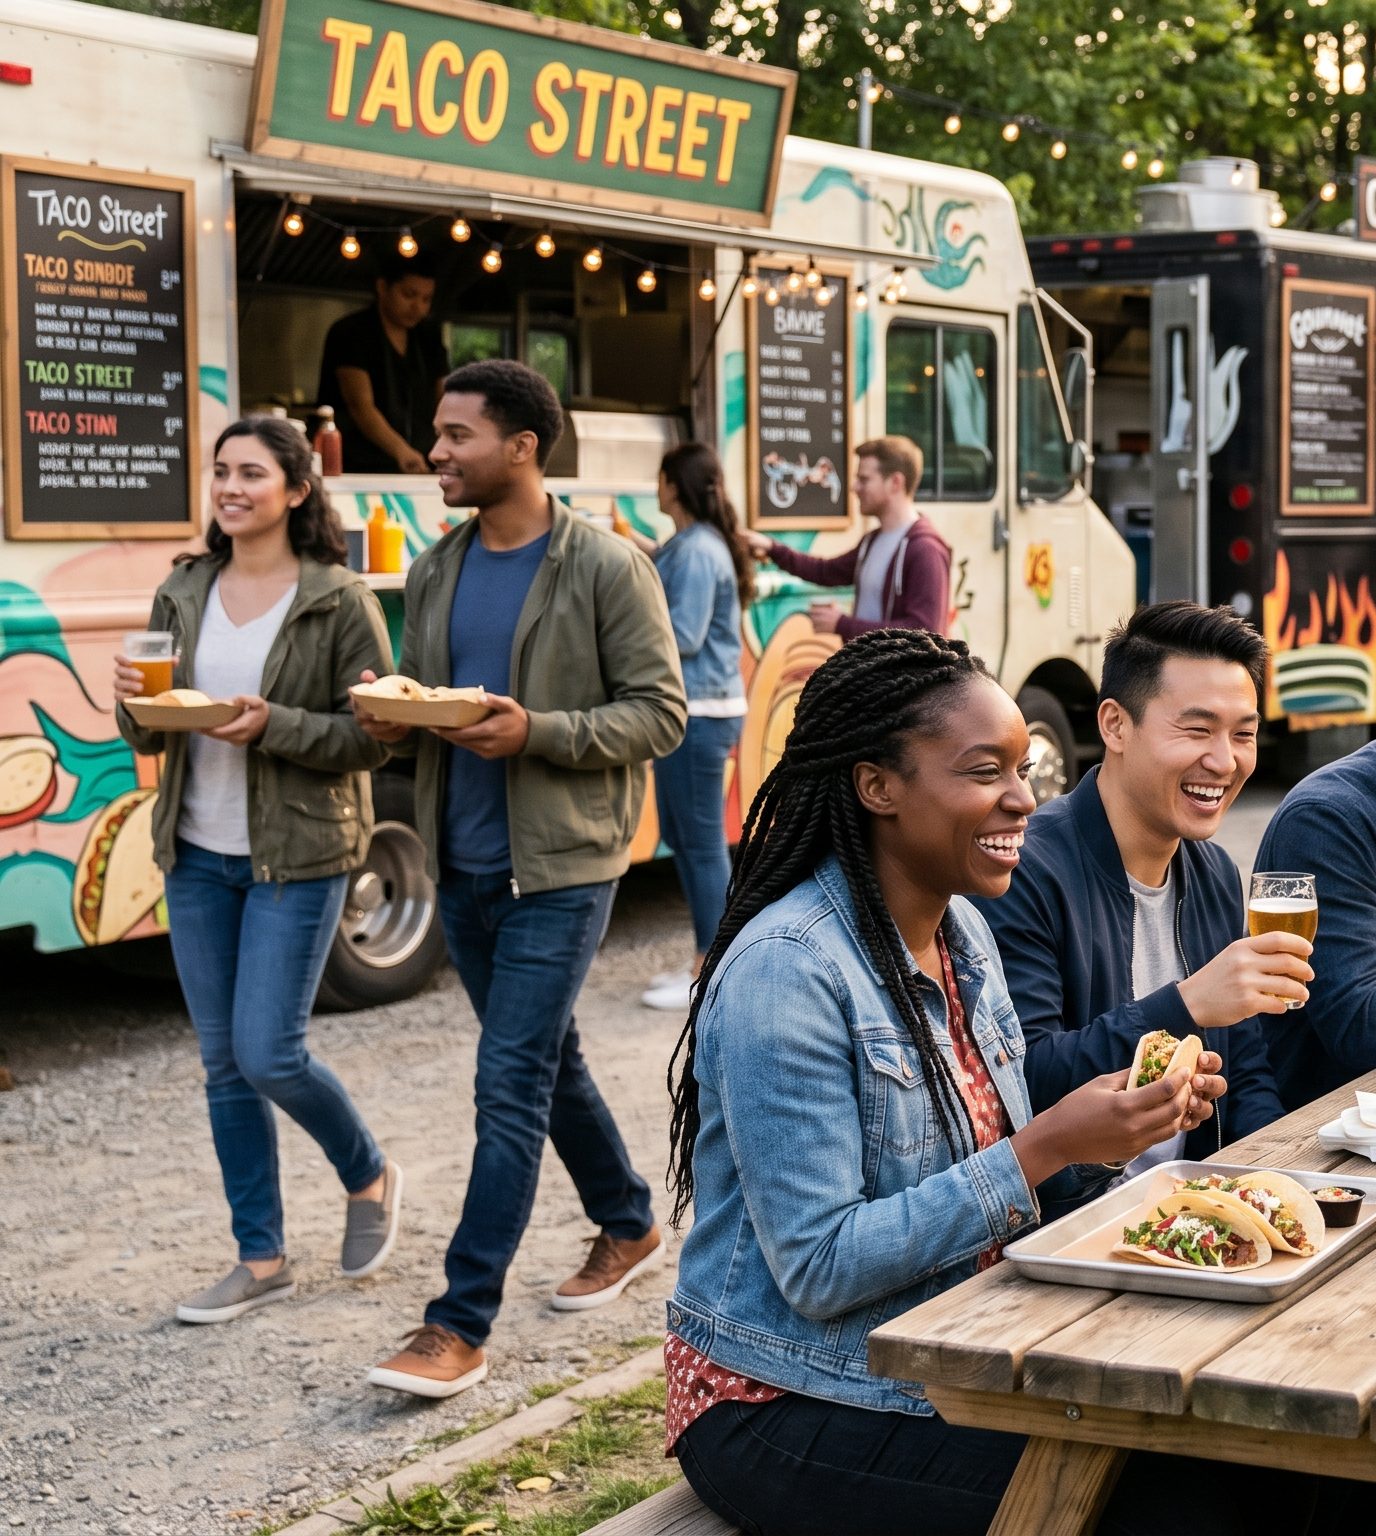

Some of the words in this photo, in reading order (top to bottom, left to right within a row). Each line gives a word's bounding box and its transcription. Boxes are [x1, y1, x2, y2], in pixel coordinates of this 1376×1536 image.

[322, 17, 509, 145] TACO
[527, 61, 751, 183] STREET
[28, 189, 91, 228] TACO
[98, 194, 168, 240] Street
[24, 253, 68, 280] TACO
[25, 360, 69, 384] TACO
[75, 363, 134, 388] STREET
[25, 410, 70, 434] TACO
